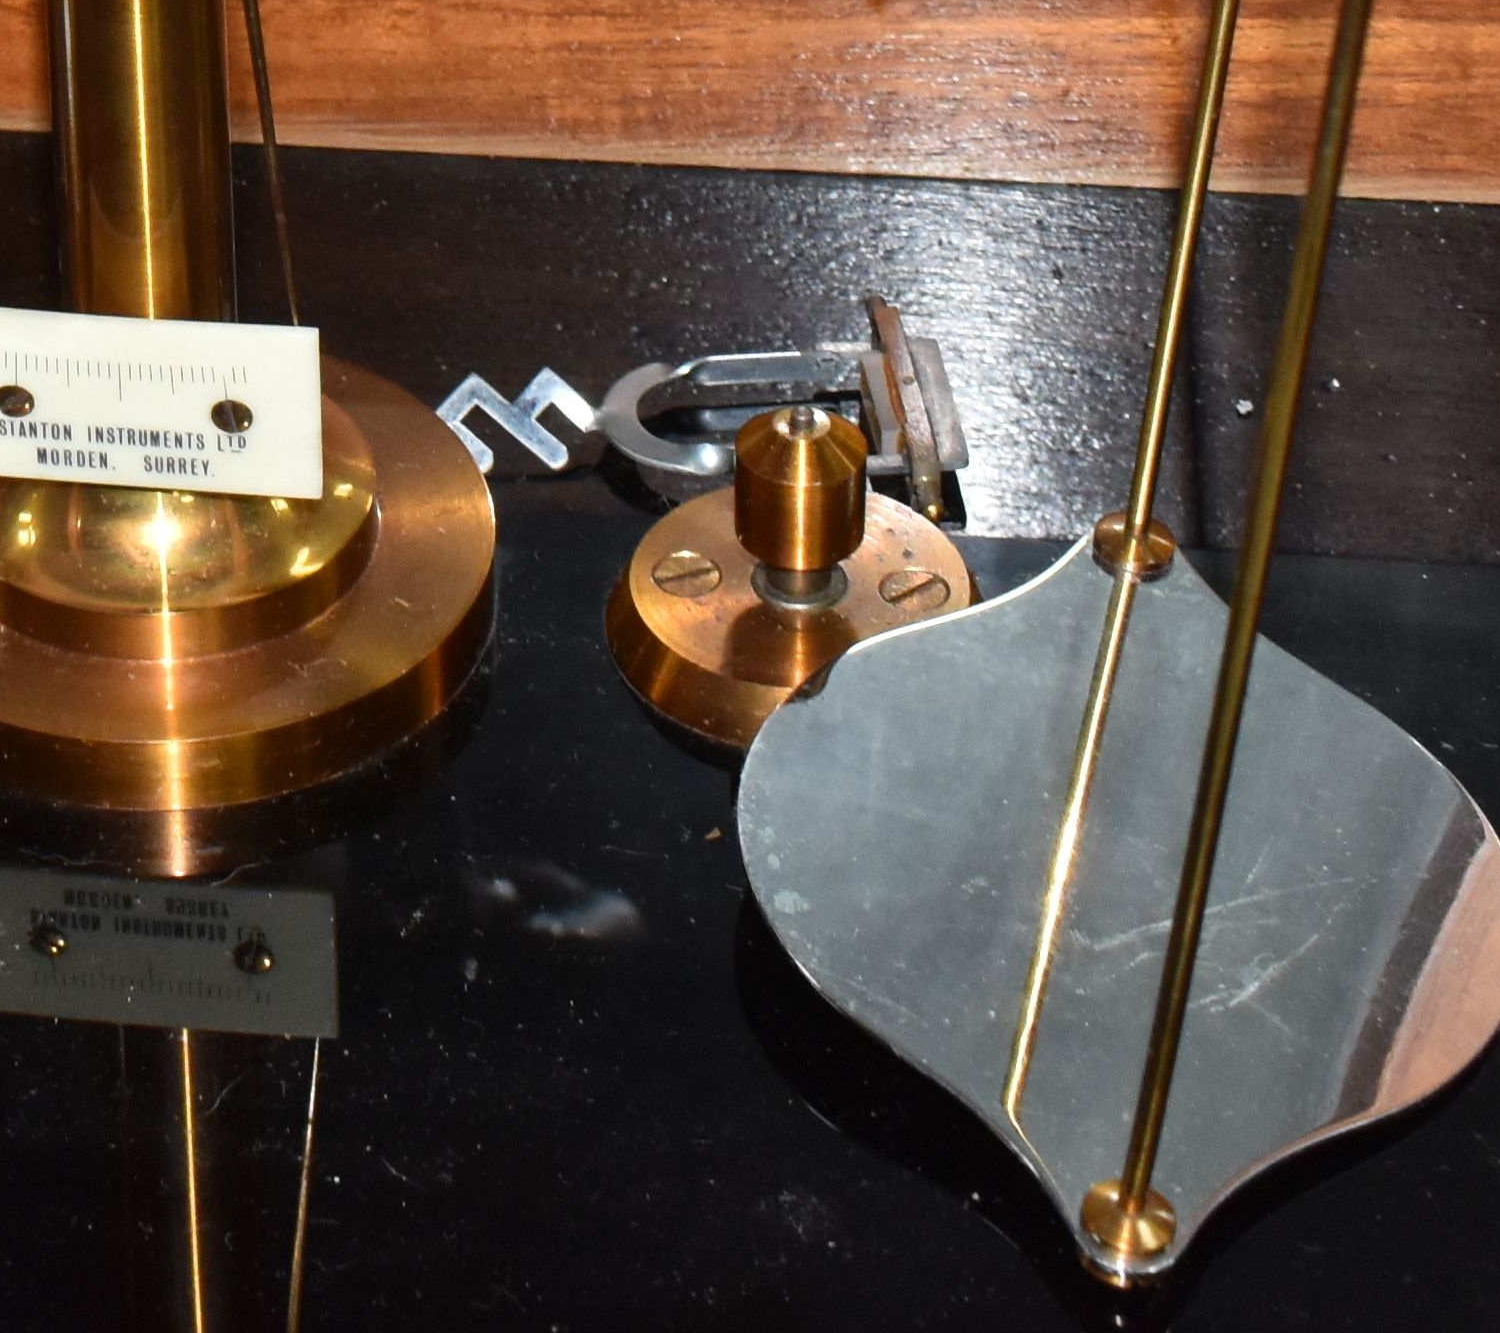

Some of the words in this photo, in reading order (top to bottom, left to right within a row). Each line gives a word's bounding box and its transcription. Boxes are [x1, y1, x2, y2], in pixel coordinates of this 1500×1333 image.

[87, 425, 205, 450] INSTRUMENTS
[36, 447, 117, 470] MORDEN.
[143, 454, 216, 477] SURREY.
